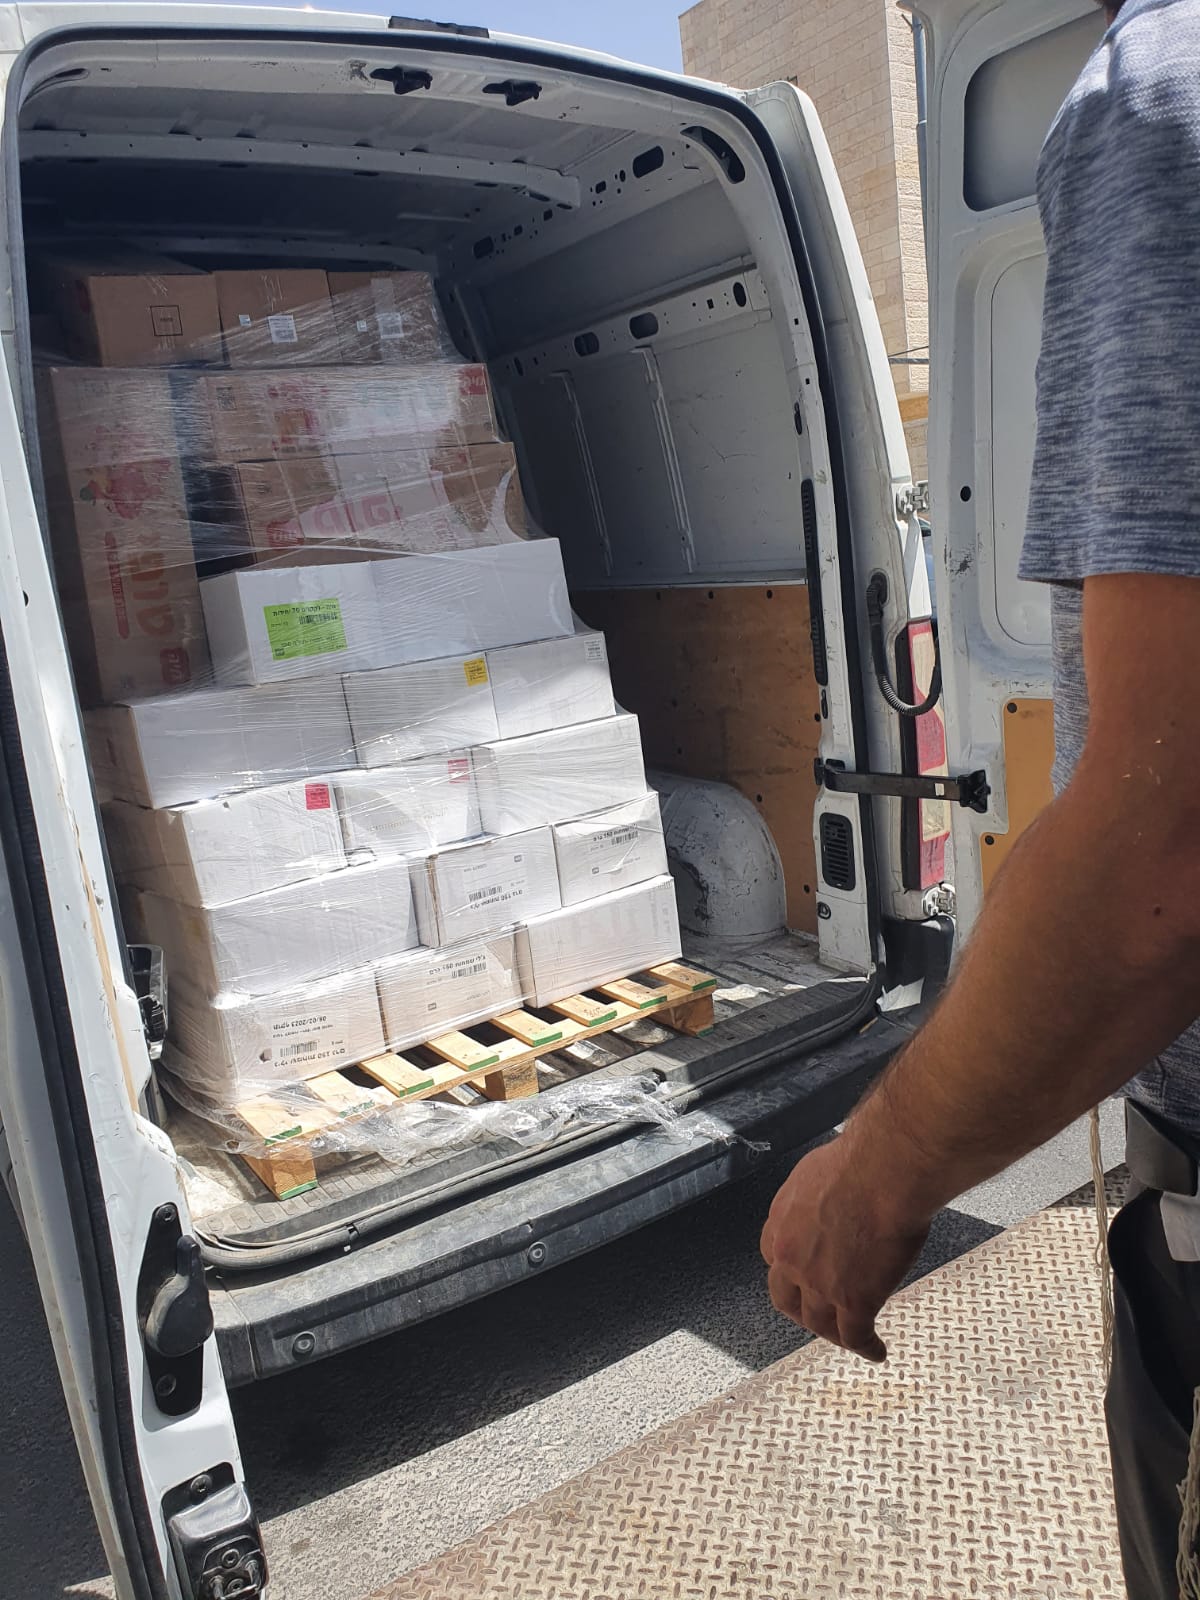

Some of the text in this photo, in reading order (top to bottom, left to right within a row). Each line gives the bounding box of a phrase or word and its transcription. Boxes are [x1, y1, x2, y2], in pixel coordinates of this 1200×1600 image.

[273, 1021, 290, 1030] תוקף
[290, 1054, 316, 1065] שמחות
[332, 1048, 346, 1056] גרם
